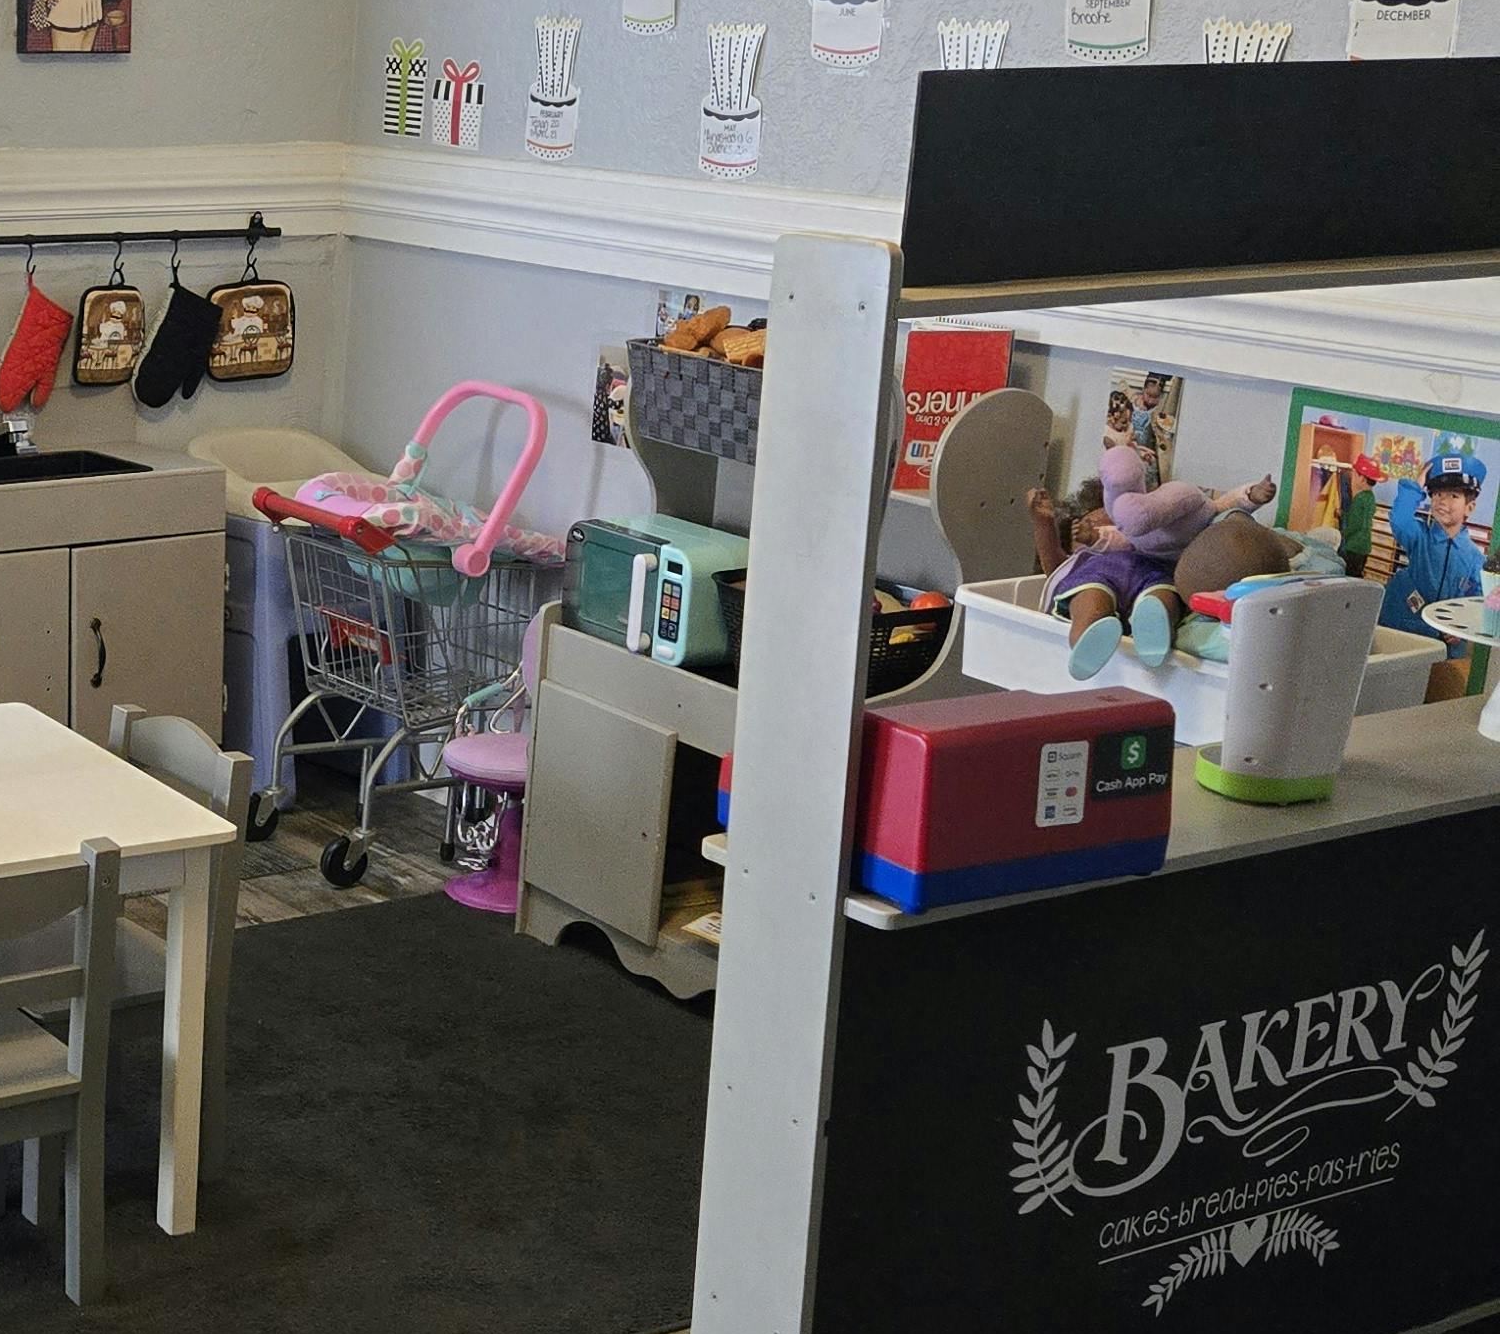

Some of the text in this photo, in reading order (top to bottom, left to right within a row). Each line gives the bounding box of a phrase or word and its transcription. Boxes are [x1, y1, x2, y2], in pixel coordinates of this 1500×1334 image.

[838, 7, 856, 17] JUNE
[1376, 9, 1432, 22] DECEMBER
[723, 123, 737, 132] MAY
[1096, 772, 1169, 793] Cash App Pay
[1072, 964, 1444, 1197] BAKERY
[1099, 1141, 1401, 1249] cakes-bread-pies-pastries
